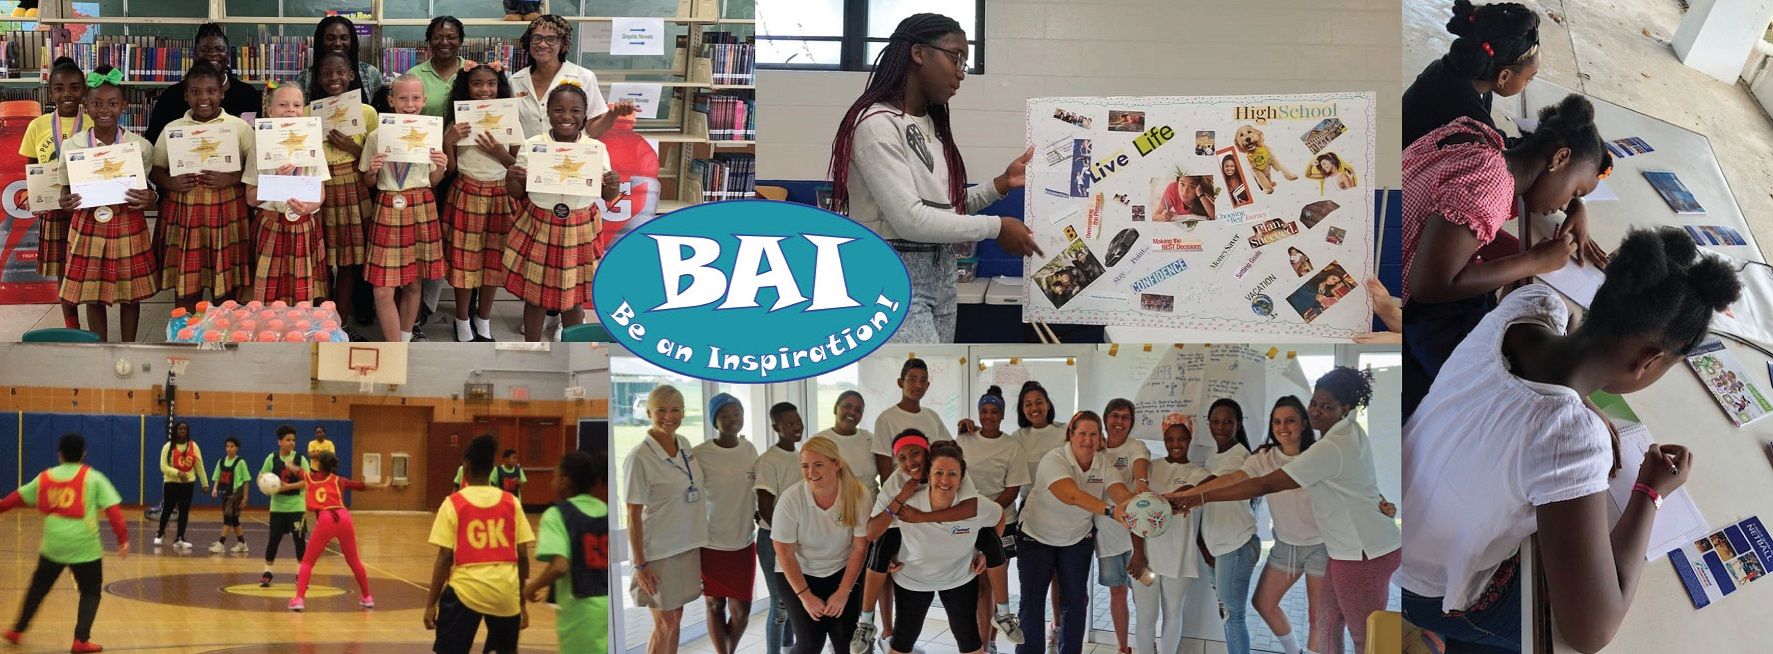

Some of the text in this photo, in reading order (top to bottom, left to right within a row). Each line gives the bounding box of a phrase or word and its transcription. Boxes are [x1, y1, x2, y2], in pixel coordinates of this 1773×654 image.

[1089, 125, 1175, 184] Live Life
[1131, 258, 1188, 295] CONFIDENCE
[1235, 261, 1253, 280] Setting
[1244, 273, 1277, 301] VACATION
[177, 456, 193, 467] GS
[466, 518, 510, 549] GK
[1746, 523, 1773, 562] NETBALL
